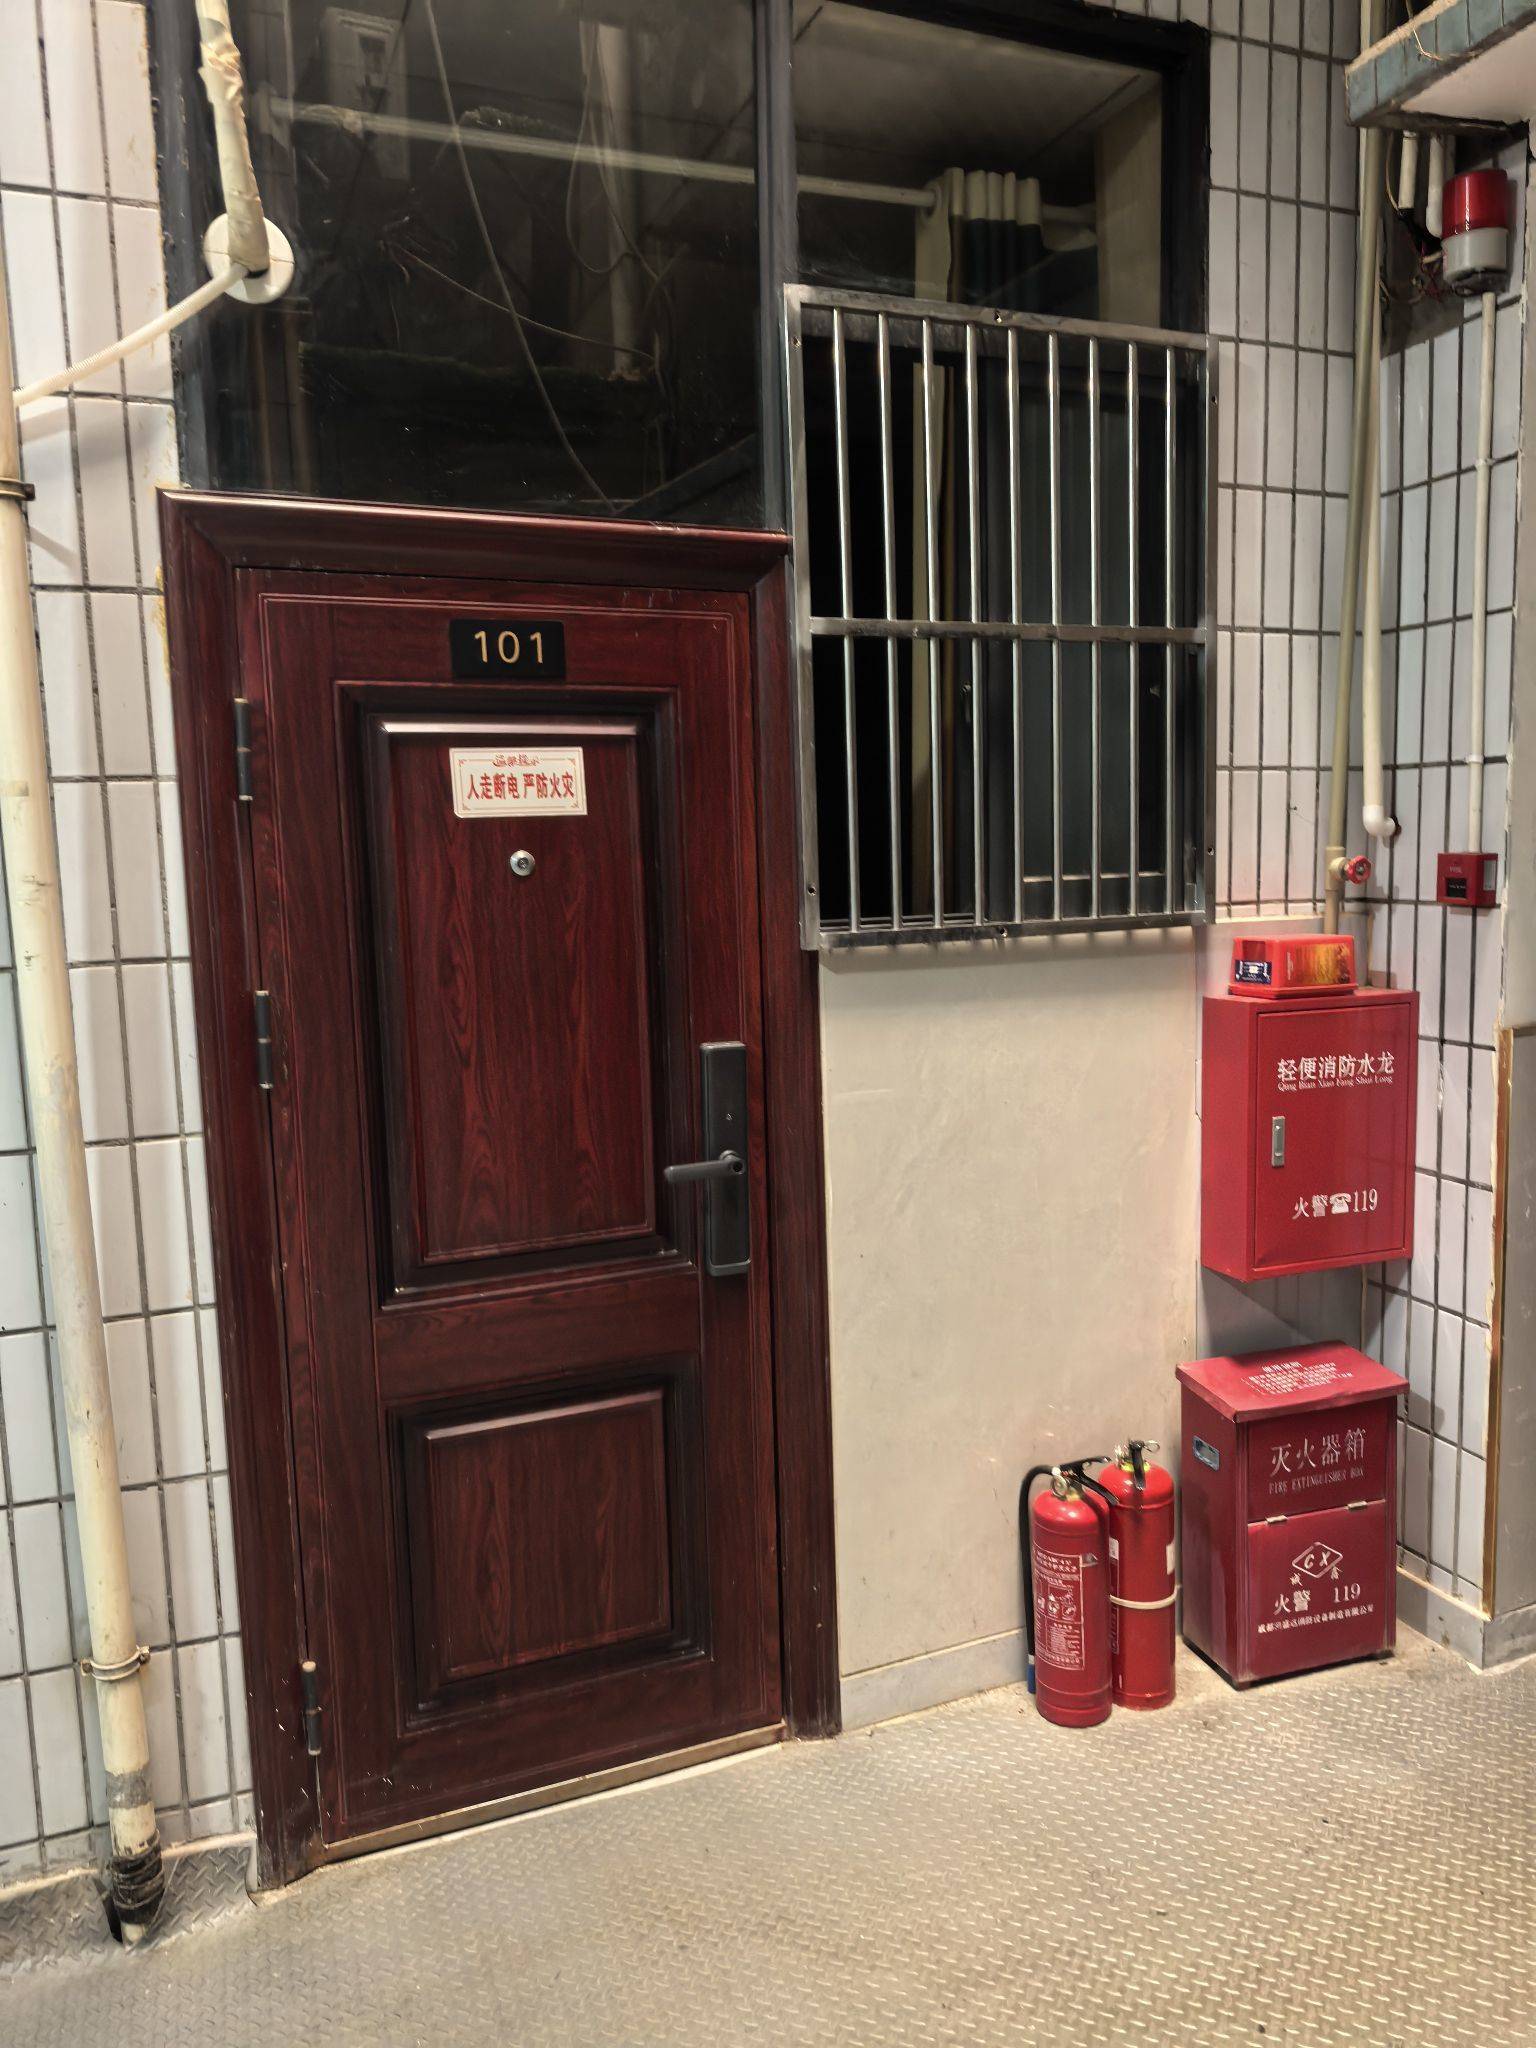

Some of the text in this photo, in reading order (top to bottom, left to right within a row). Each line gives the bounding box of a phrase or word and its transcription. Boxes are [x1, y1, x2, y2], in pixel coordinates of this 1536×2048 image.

[474, 630, 543, 664] 101
[467, 771, 575, 799] 人走断电严防火灾
[1277, 1051, 1395, 1082] 轻便消防水龙
[1292, 1188, 1378, 1220] 火警 119
[1269, 1428, 1366, 1477] 灭火器箱
[1273, 1583, 1361, 1616] 火警 119
